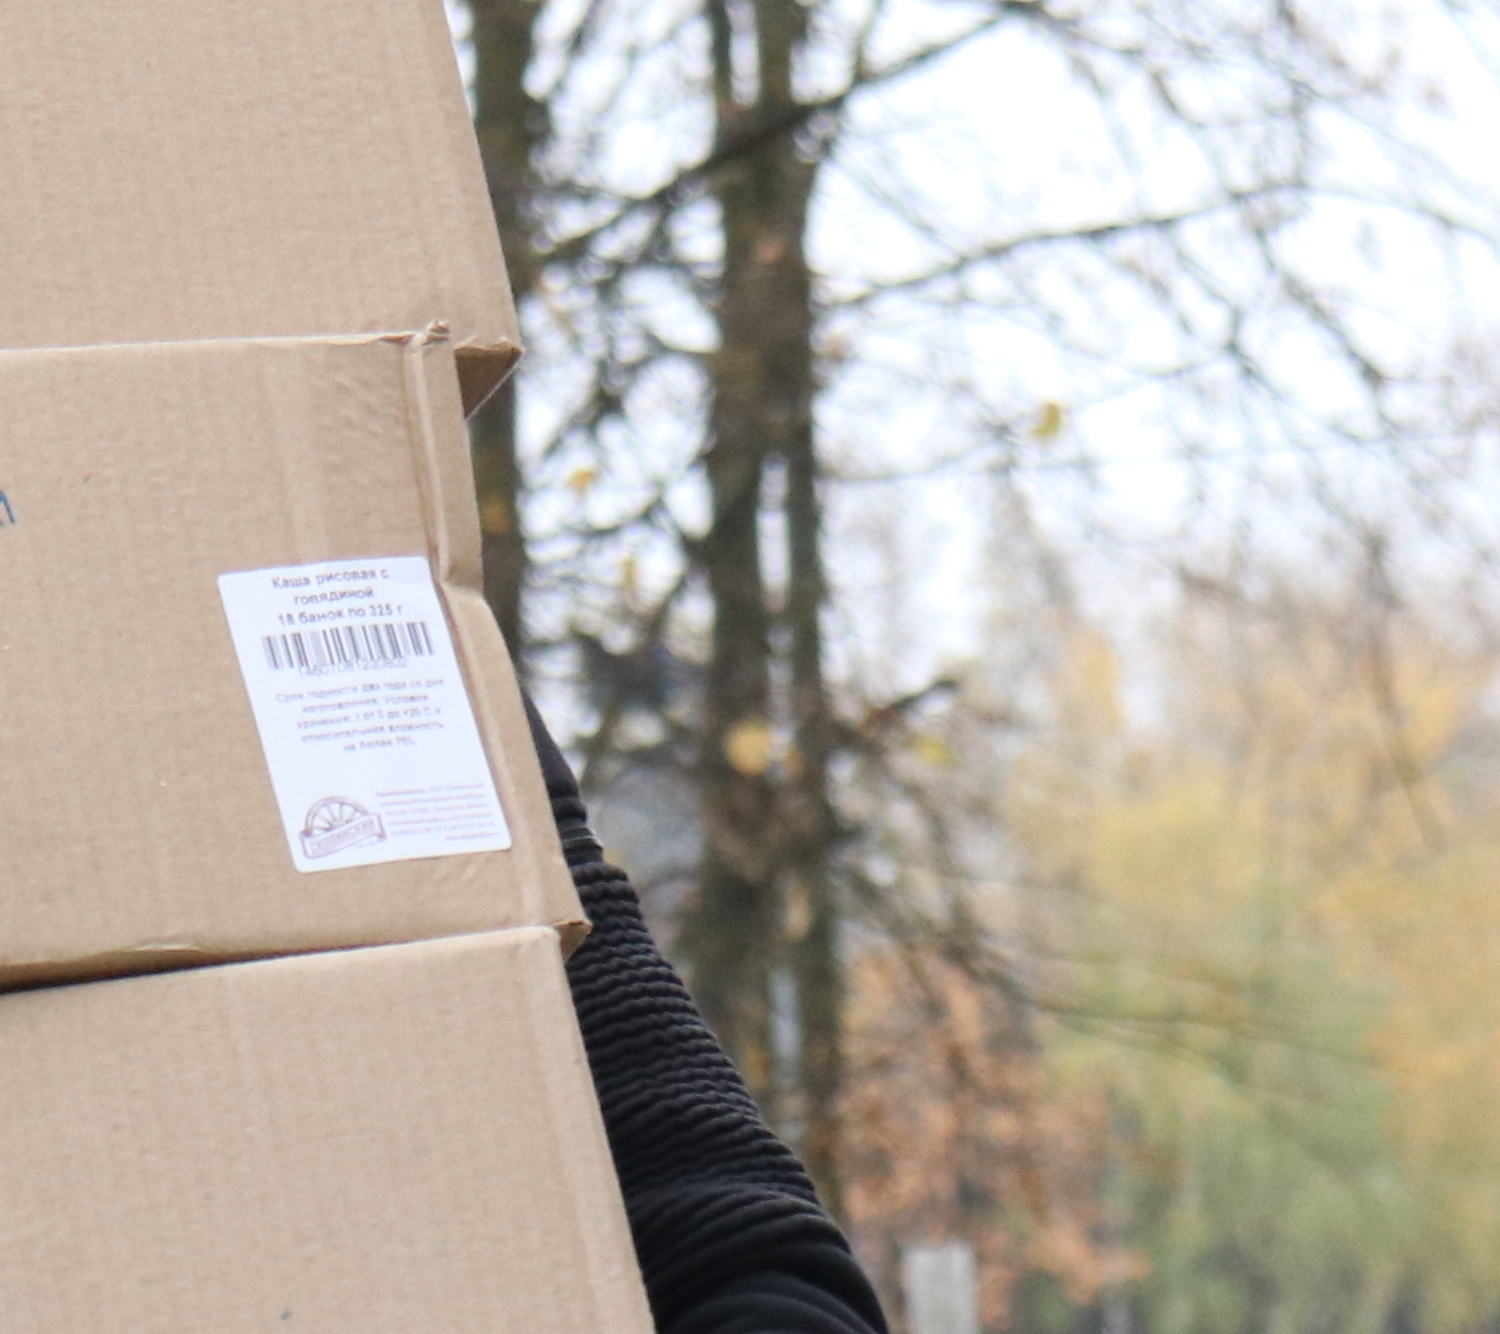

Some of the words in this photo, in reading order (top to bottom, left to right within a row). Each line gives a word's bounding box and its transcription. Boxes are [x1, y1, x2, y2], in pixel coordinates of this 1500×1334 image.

[271, 575, 310, 589] Каша
[316, 569, 376, 585] рисовая
[293, 587, 374, 606] говядиной
[277, 614, 295, 625] 18
[298, 609, 344, 624] банок
[347, 607, 366, 618] по
[367, 604, 393, 616] 325
